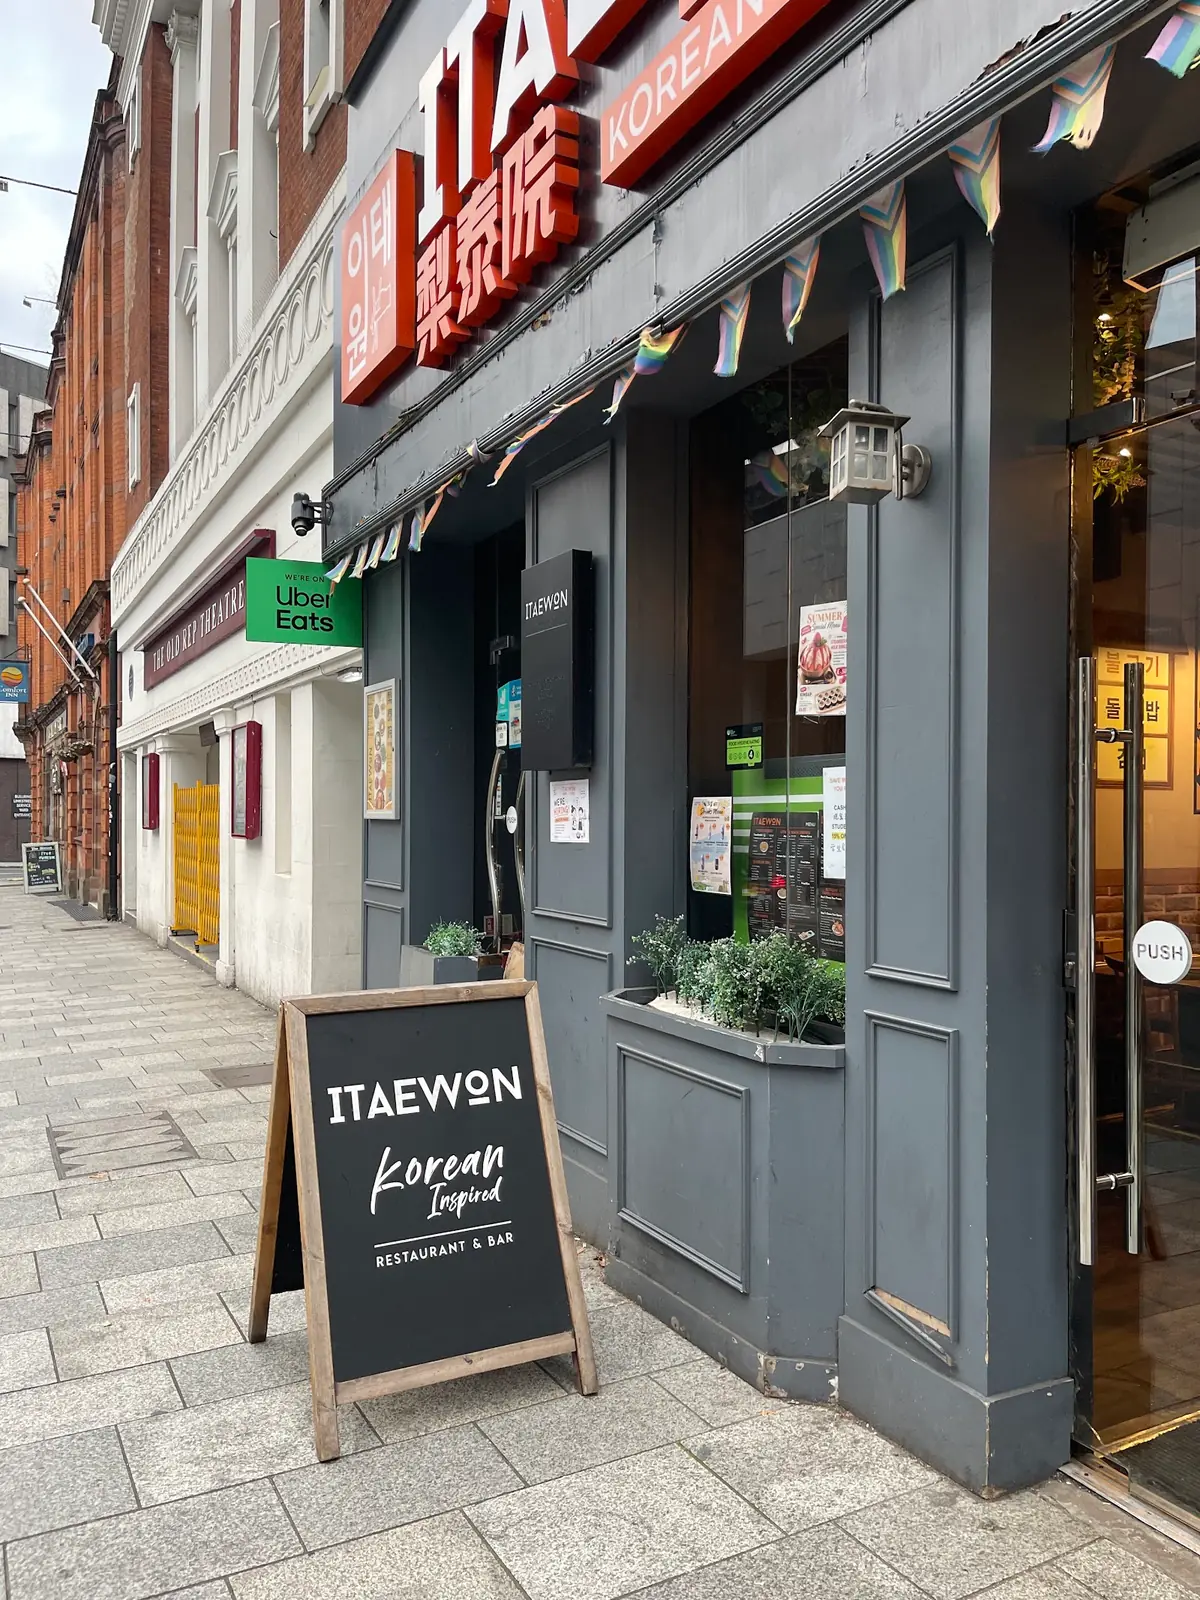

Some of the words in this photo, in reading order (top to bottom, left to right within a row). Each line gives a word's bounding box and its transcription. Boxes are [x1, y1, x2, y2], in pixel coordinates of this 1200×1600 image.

[418, 0, 615, 245] ITA
[285, 574, 310, 582] WE'RE
[276, 585, 333, 609] Uber
[525, 589, 568, 620] ITAEWON
[153, 646, 165, 672] THE
[166, 634, 180, 662] OLD
[182, 620, 197, 652] REP
[200, 579, 244, 638] THEATRE
[276, 609, 334, 632] Eats
[807, 612, 842, 623] SUMMER
[1137, 944, 1183, 961] PUSH
[327, 1066, 522, 1124] ITAEWON
[427, 1176, 503, 1220] Inspired
[376, 1240, 465, 1268] RESTAURANT
[472, 1238, 482, 1250] &
[488, 1232, 514, 1247] BAR
